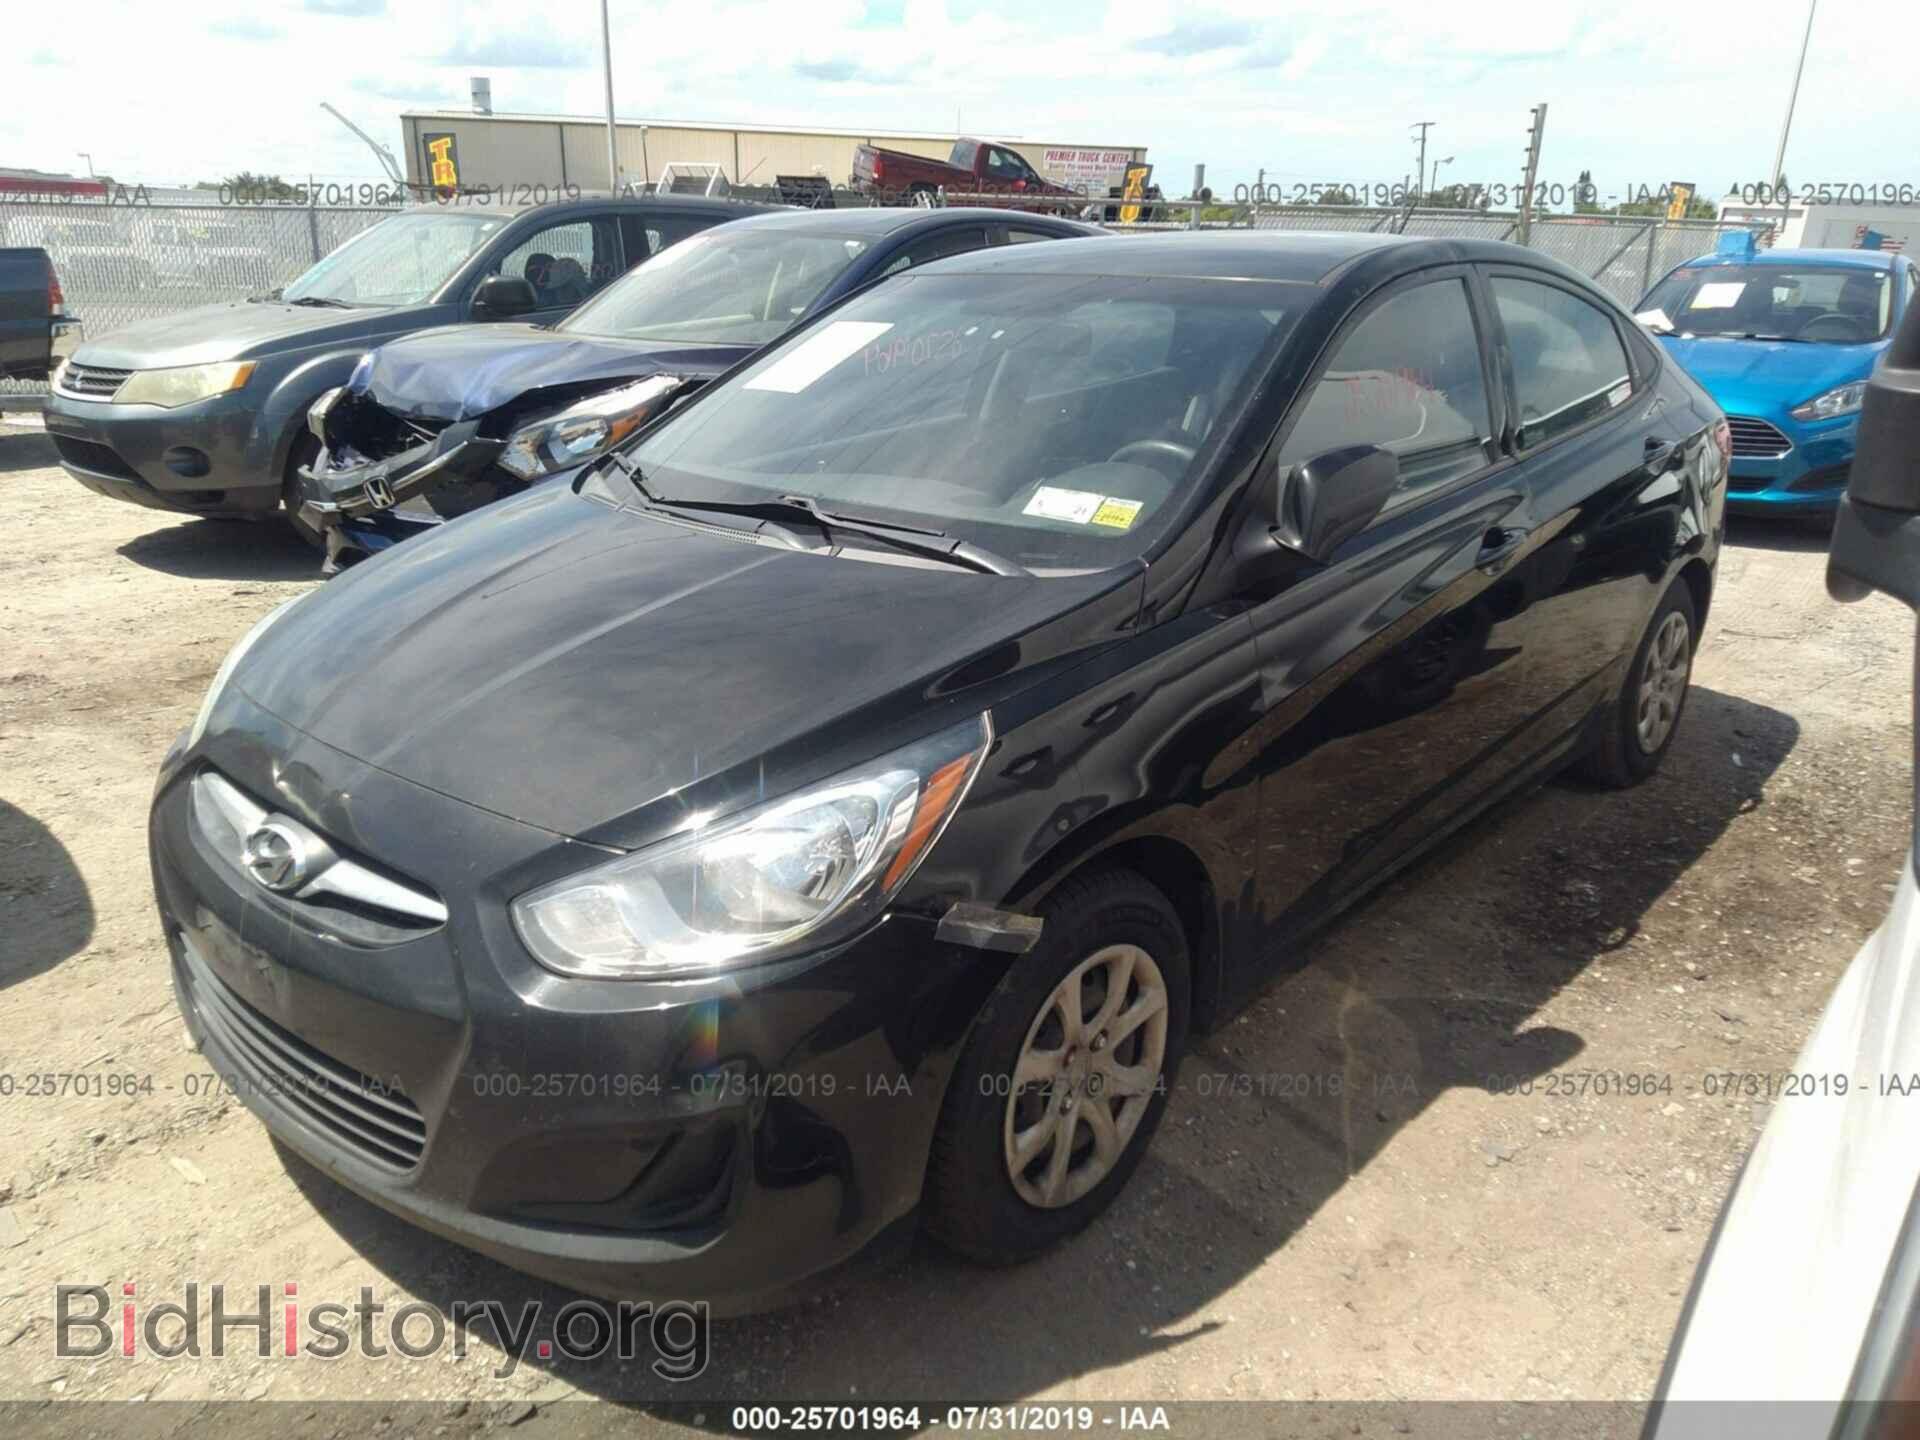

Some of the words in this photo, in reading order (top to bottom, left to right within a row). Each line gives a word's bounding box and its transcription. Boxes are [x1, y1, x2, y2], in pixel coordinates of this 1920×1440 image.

[1045, 150, 1076, 160] PREMIER
[1078, 151, 1101, 163] TRUCK
[1102, 152, 1130, 163] CENTER
